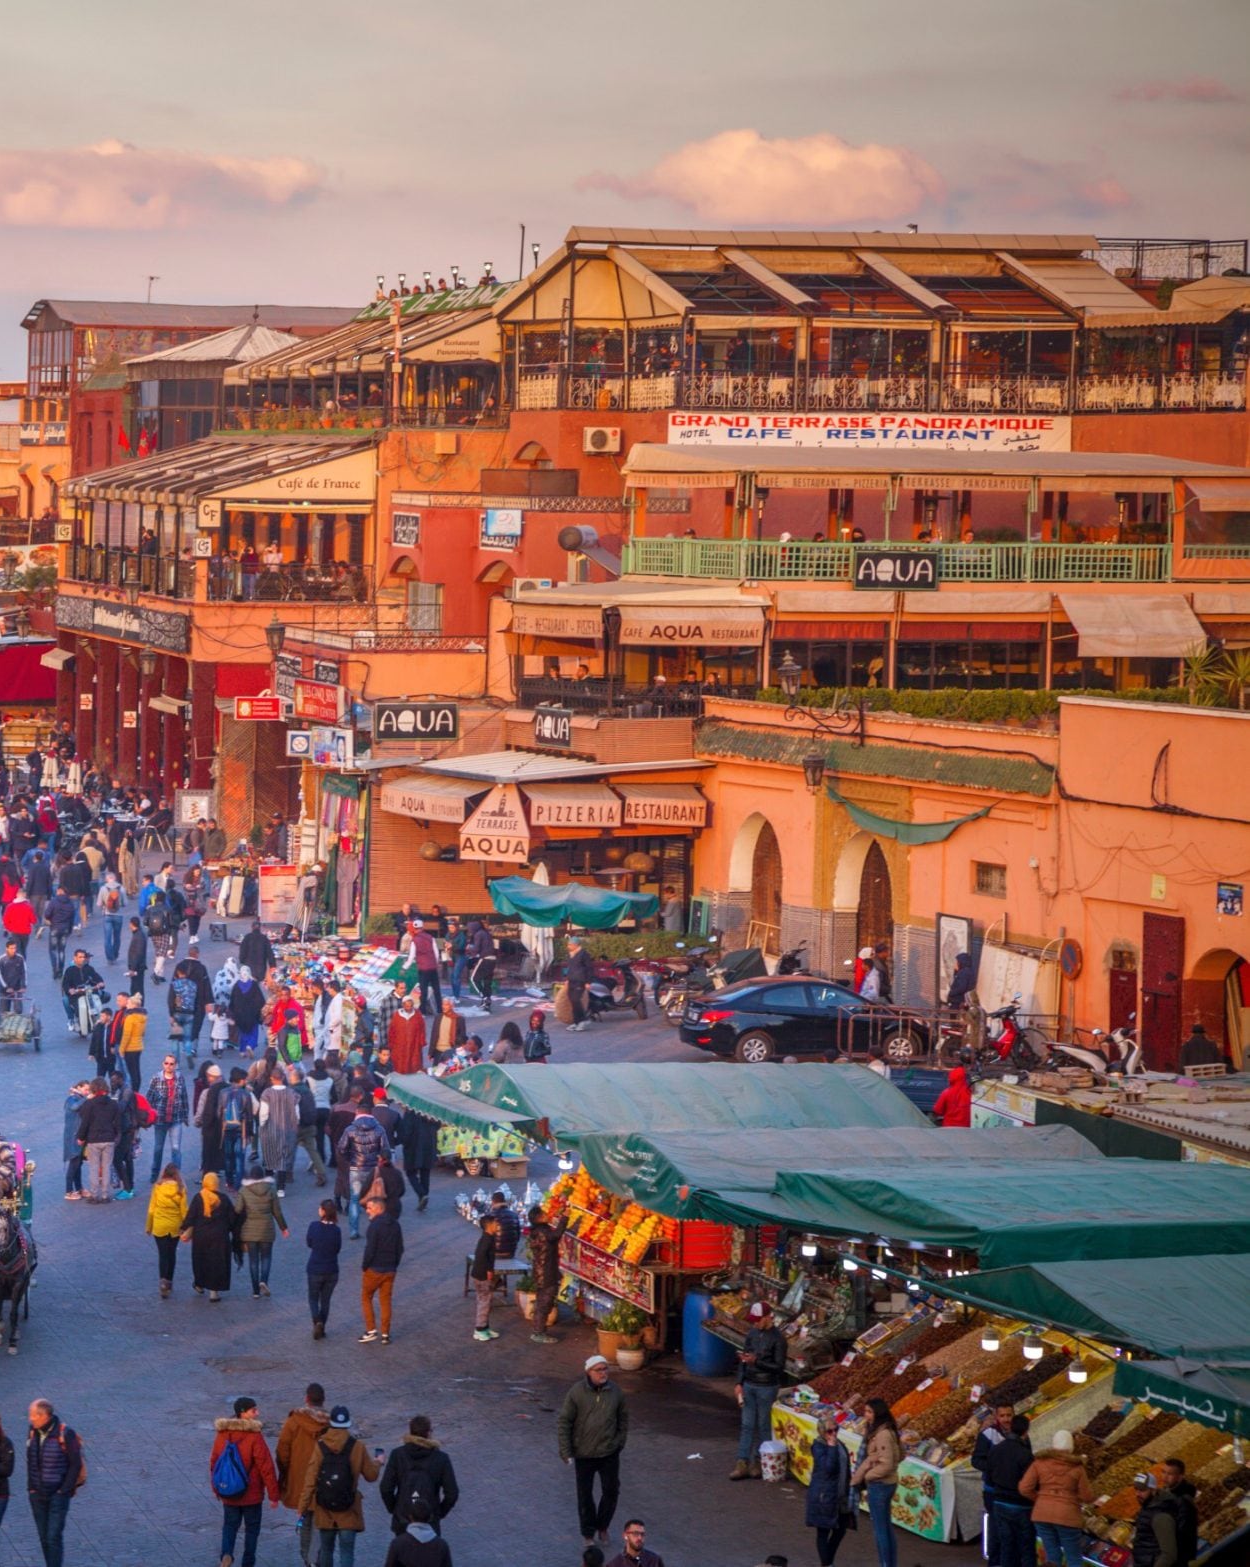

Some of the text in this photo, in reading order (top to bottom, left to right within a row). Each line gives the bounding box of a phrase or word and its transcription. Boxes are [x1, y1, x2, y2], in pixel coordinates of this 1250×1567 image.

[405, 290, 446, 314] DE
[671, 415, 1054, 431] GRAND TERRASSE PANORAMIQUE
[679, 429, 711, 439] HOTEL
[728, 428, 994, 440] CAFE RESTAURANT
[277, 477, 361, 493] Café de France
[793, 477, 841, 488] RESTAURANT
[853, 478, 888, 488] PIZZERIA
[906, 477, 1030, 489] TERRASSE PANORAMIQUE
[858, 558, 933, 582] AQUA
[623, 625, 760, 640] CAFÉ AQUA RESTAURANT
[379, 709, 454, 733] AQUA
[535, 715, 570, 741] AQUA
[400, 796, 425, 812] AQUA
[536, 802, 705, 824] PIZZERIA RESTAURANT
[476, 818, 519, 832] TERRASSE
[462, 837, 527, 856] AQUA
